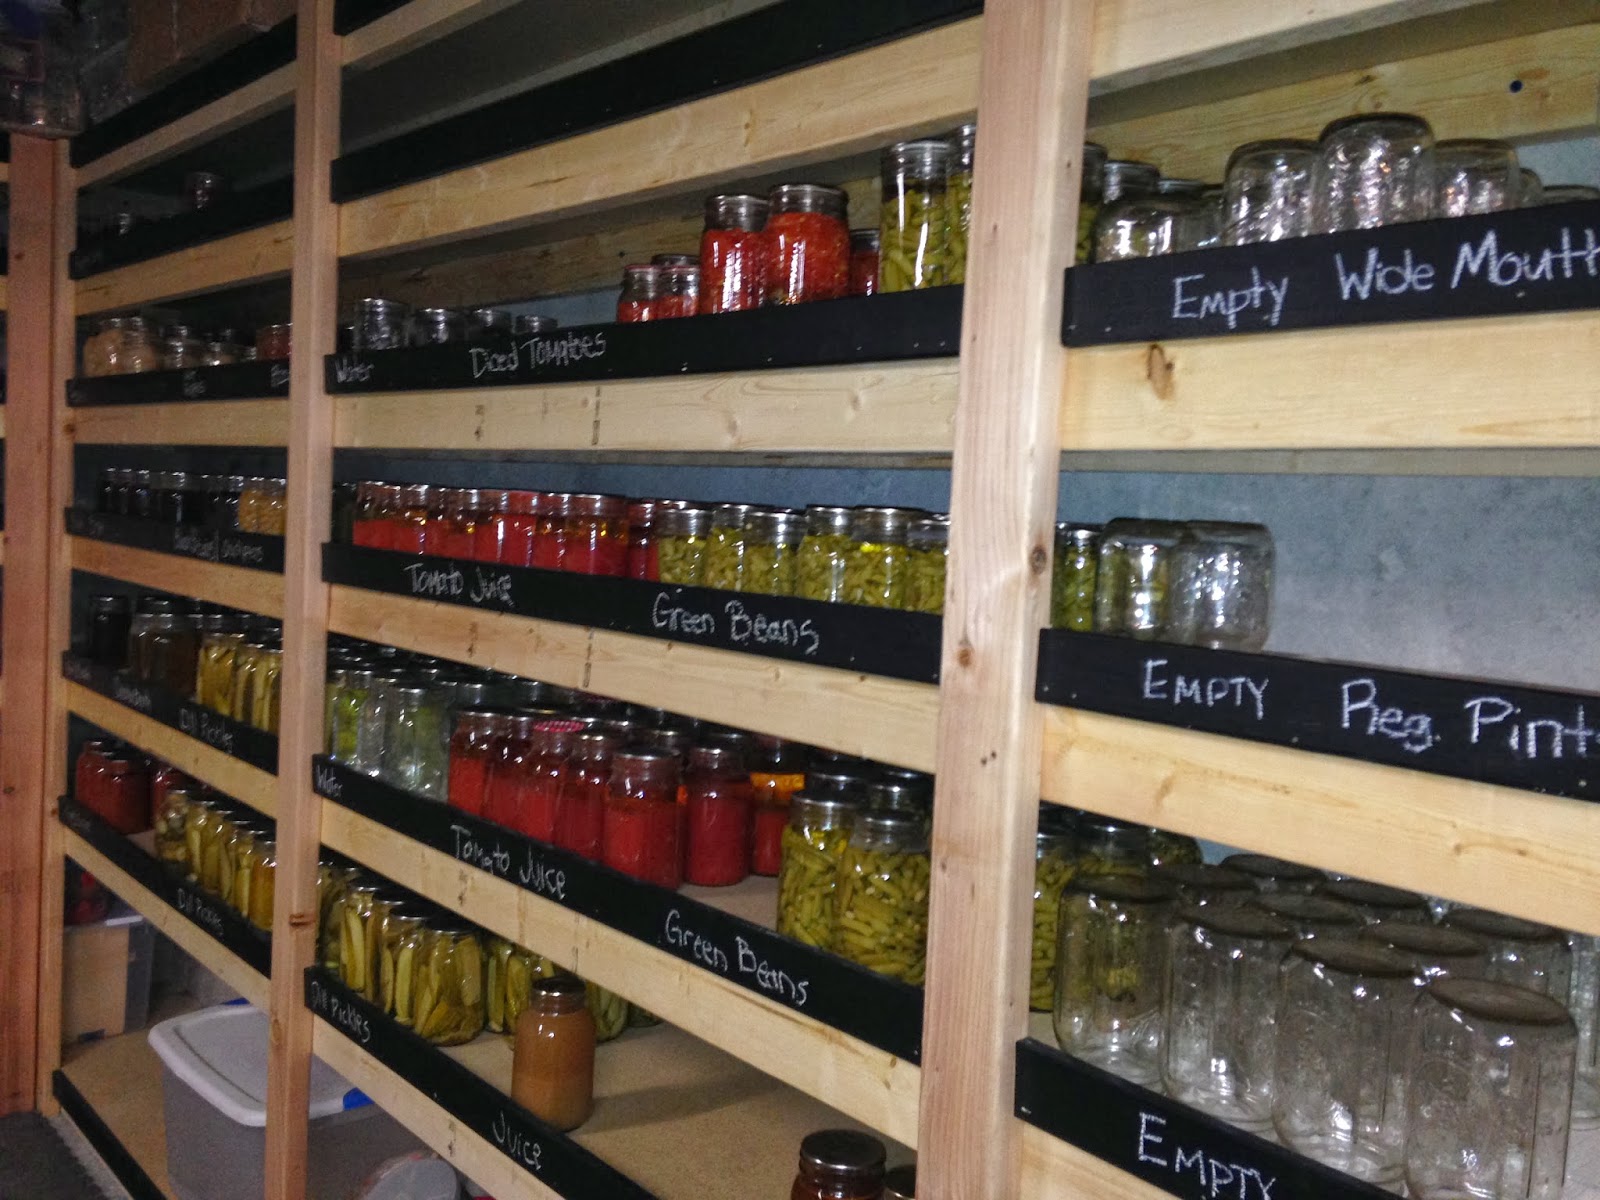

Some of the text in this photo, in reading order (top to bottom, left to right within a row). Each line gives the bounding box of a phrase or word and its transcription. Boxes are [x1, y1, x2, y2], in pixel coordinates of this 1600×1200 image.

[1171, 266, 1289, 330] Empty
[1335, 246, 1436, 301] Wide
[404, 562, 464, 596] Tomato
[652, 590, 820, 655] Green Beans
[1341, 678, 1441, 753] Reg.
[1464, 697, 1600, 759] Pint
[451, 824, 566, 900] Tomato Juice
[664, 909, 810, 1006] Green Beans
[492, 1110, 542, 1171] Juice
